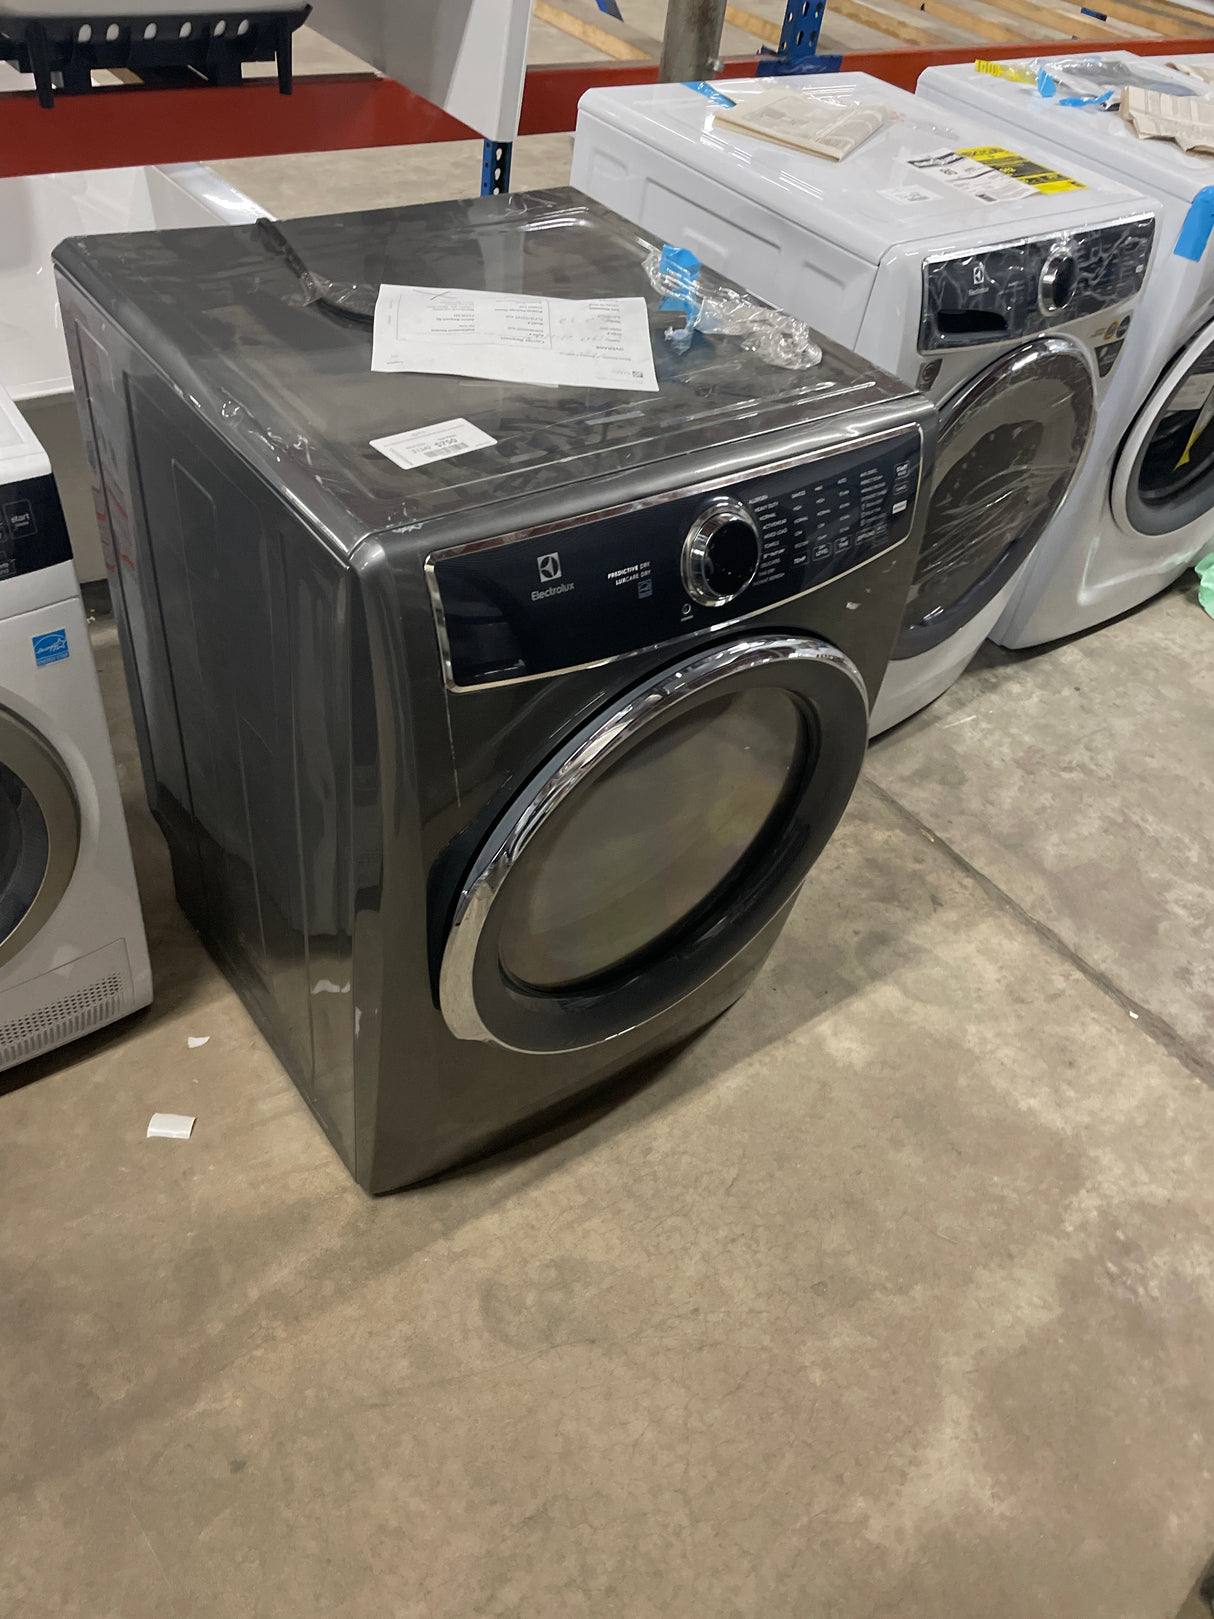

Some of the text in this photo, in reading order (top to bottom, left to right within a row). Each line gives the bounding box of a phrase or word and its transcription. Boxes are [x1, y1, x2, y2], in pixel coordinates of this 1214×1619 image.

[11, 513, 30, 523] start
[607, 564, 639, 580] PREDICTIVE
[531, 582, 575, 601] Electrolux
